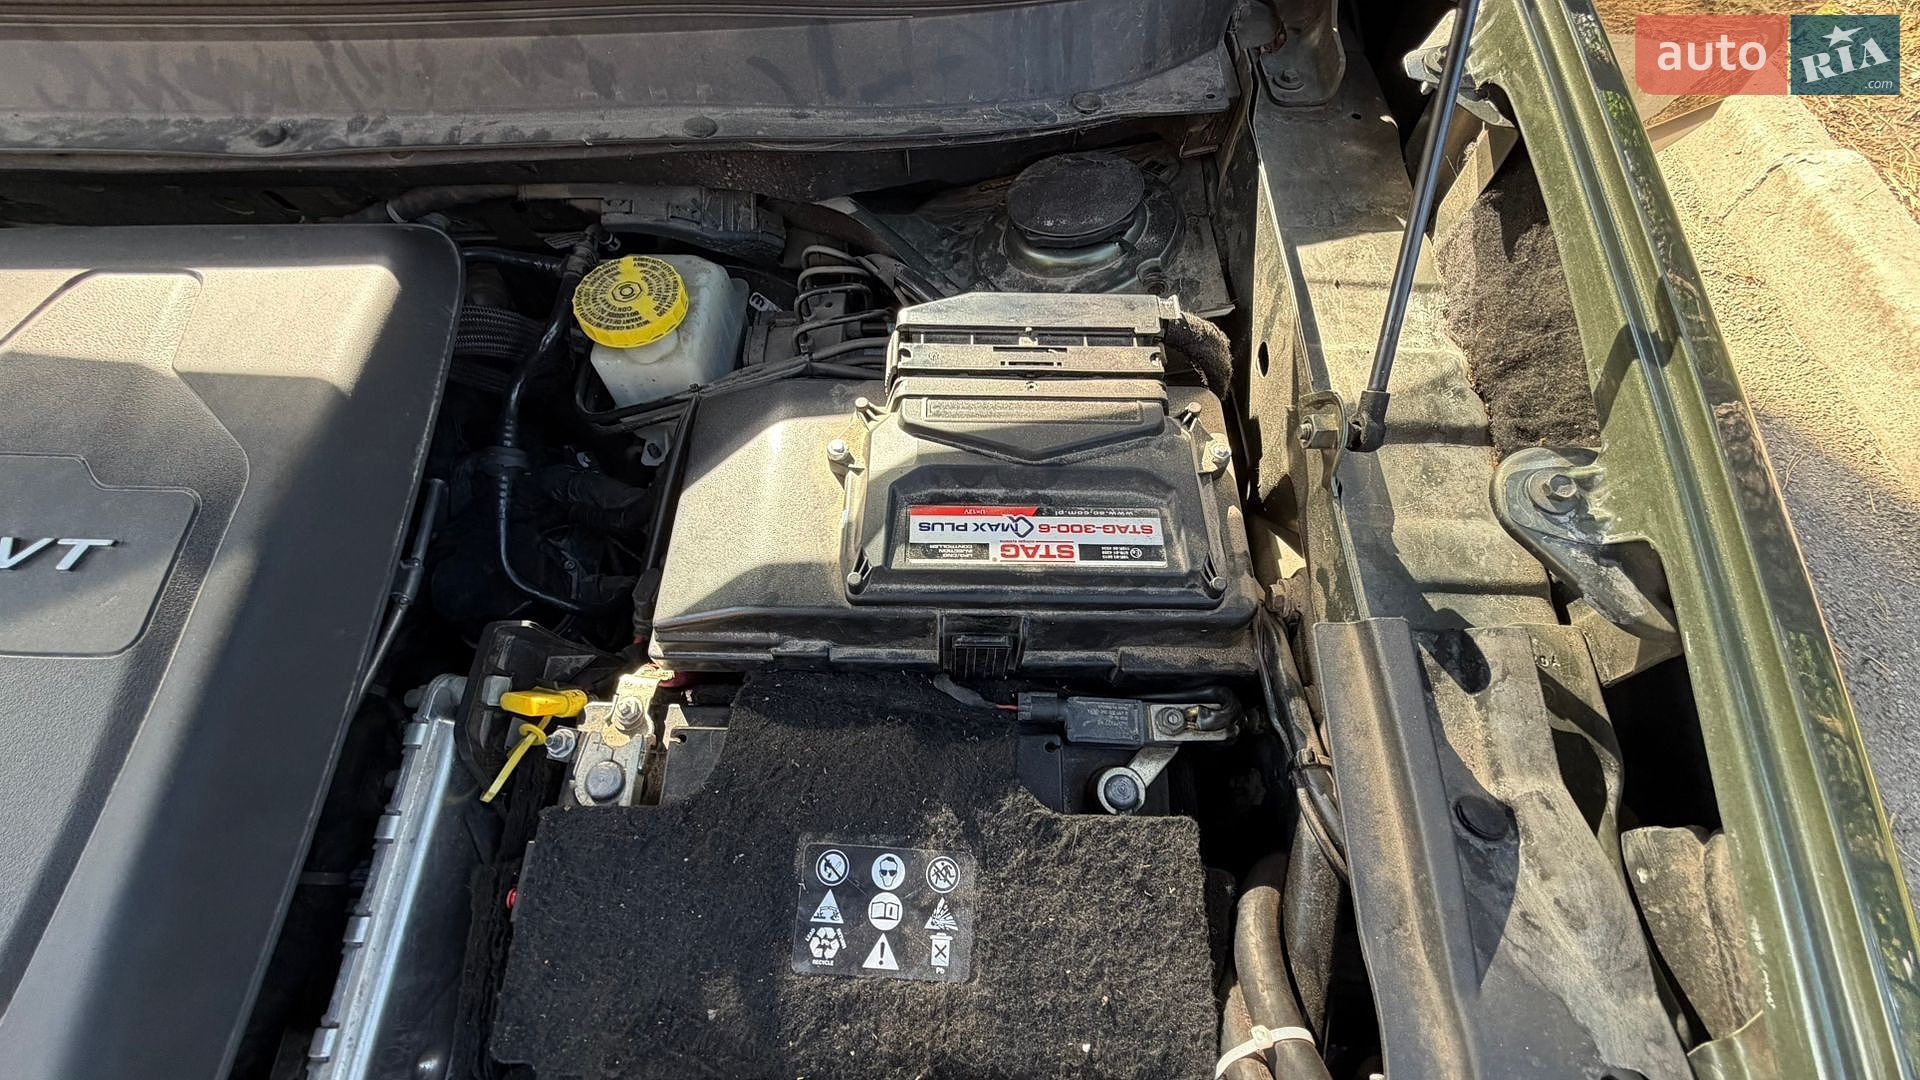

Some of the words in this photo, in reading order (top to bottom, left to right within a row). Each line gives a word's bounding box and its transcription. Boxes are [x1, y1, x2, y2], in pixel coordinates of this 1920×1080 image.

[918, 522, 968, 532] PLUS
[1038, 524, 1153, 535] STAG-300-6
[1000, 544, 1074, 559] STAG
[811, 959, 834, 967] RECYCLE
[936, 967, 945, 975] Pb
